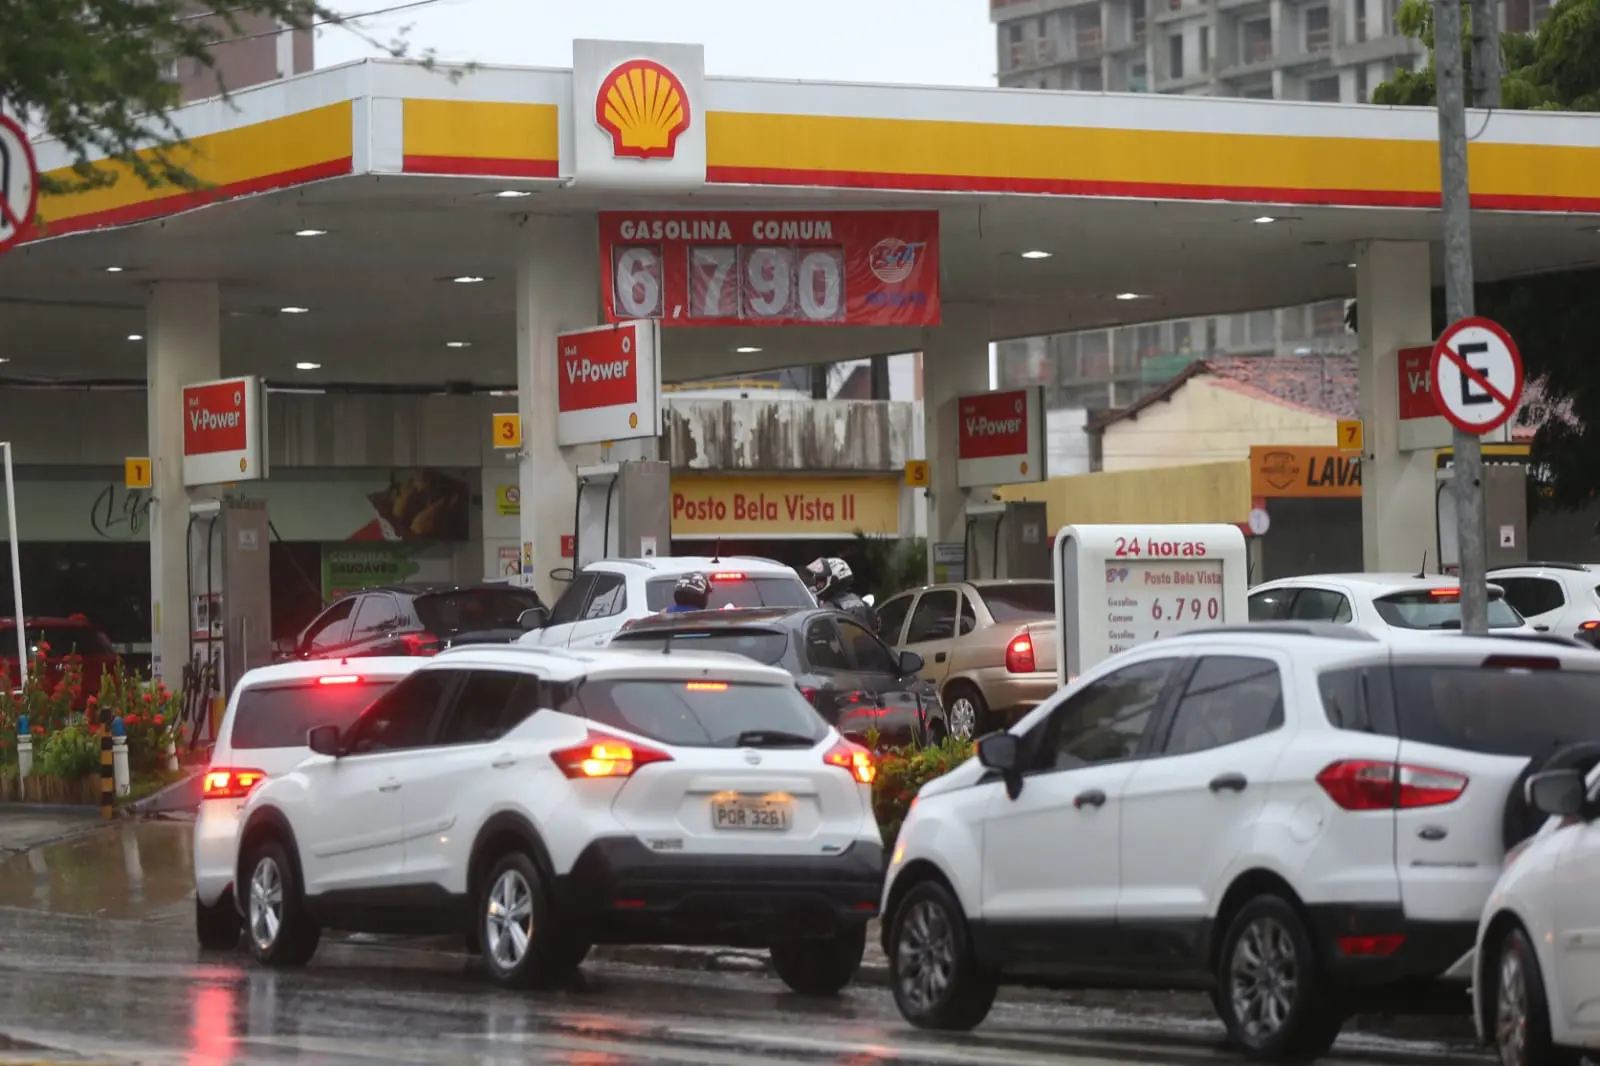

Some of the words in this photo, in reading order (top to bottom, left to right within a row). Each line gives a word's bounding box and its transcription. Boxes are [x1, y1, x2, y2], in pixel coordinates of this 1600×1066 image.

[619, 220, 732, 240] GASOLINA
[752, 220, 832, 240] COMUM
[566, 358, 629, 385] V-Power
[1457, 341, 1493, 406] E
[190, 408, 240, 432] V-Power
[965, 415, 1021, 437] V-Power
[502, 422, 514, 440] 3
[1345, 427, 1357, 442] 7
[135, 465, 143, 481] 1
[672, 493, 727, 520] Posto
[733, 493, 778, 520] Bela
[784, 493, 835, 521] Vista
[841, 493, 855, 520] II
[1114, 537, 1141, 556] 24
[1147, 537, 1206, 556] horas
[1144, 571, 1171, 584] Posto
[1173, 571, 1195, 584] Bela
[1196, 571, 1222, 584] Vista
[1151, 597, 1218, 620] 6.790
